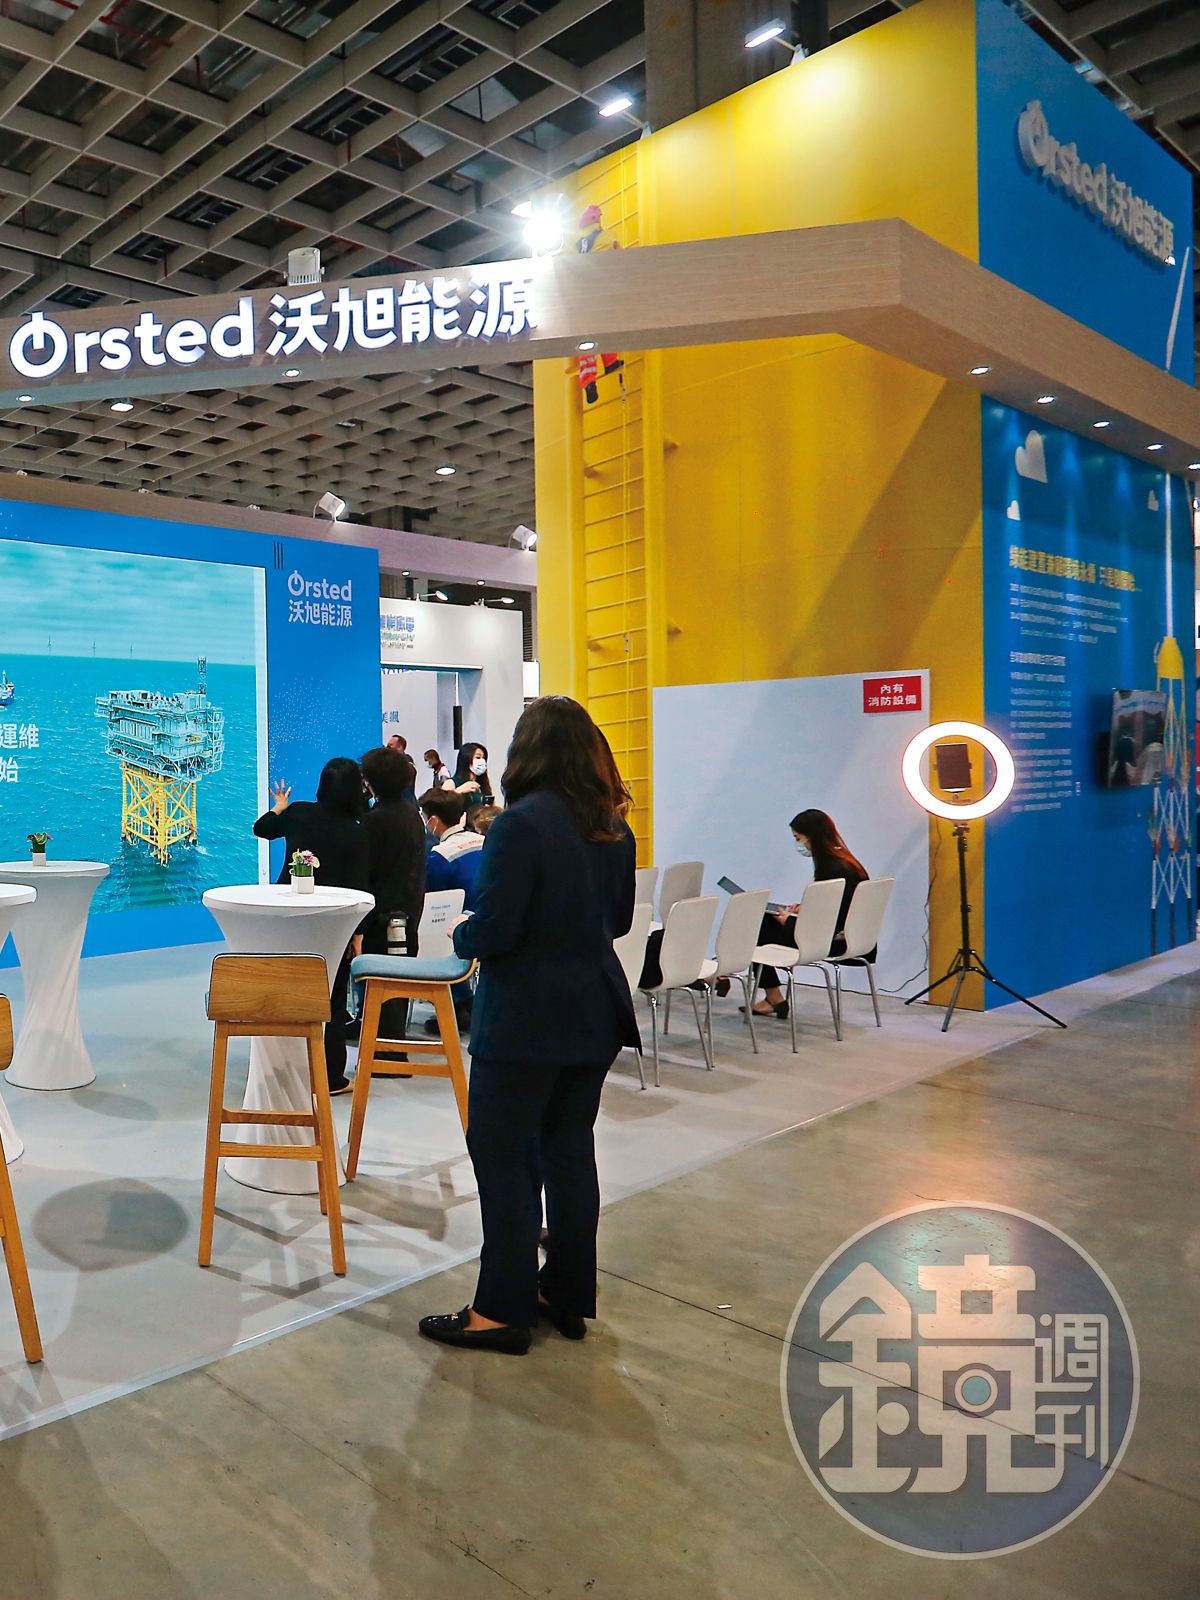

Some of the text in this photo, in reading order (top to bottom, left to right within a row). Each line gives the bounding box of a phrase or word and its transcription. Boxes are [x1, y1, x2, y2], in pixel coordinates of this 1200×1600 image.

[267, 276, 541, 357] 沃旭能源
[288, 599, 353, 628] 沃旭能源
[868, 694, 917, 707] 消防設備
